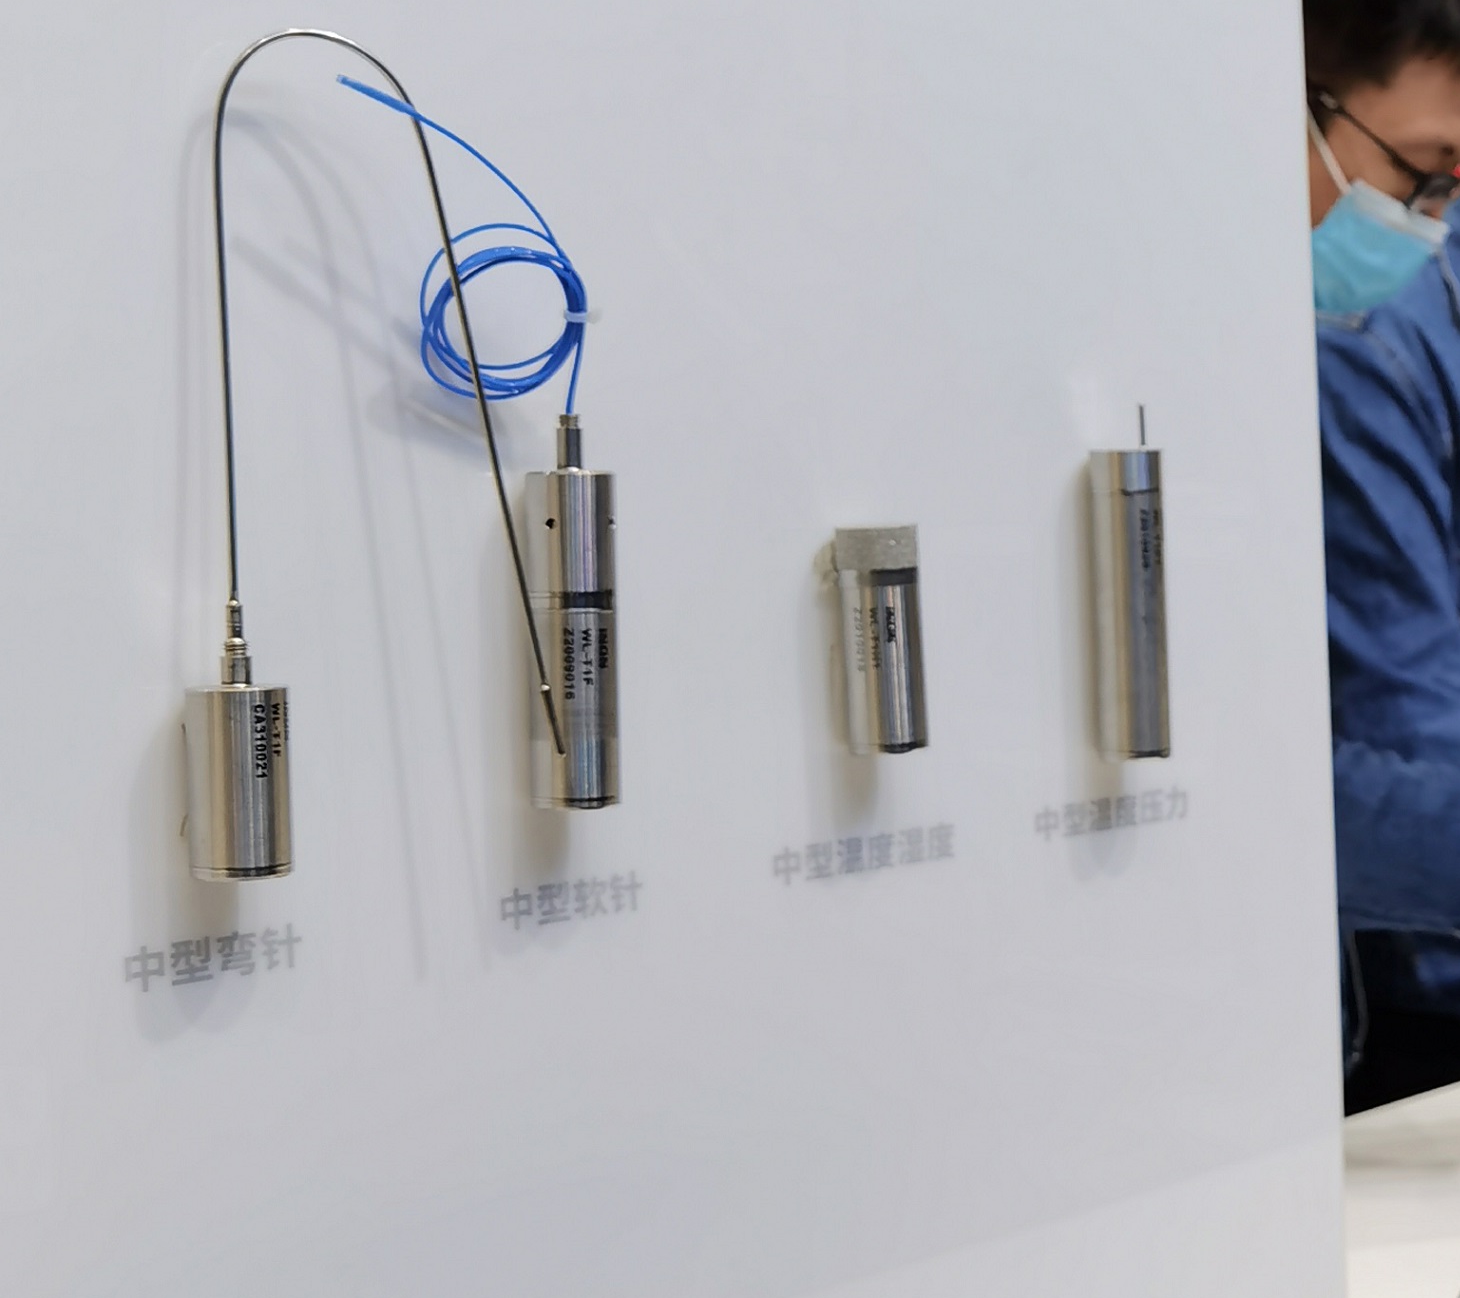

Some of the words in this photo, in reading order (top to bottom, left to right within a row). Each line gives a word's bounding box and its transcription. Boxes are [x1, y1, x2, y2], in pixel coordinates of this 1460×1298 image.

[500, 870, 644, 931] 中型软针
[124, 923, 302, 992] 中型弯针
